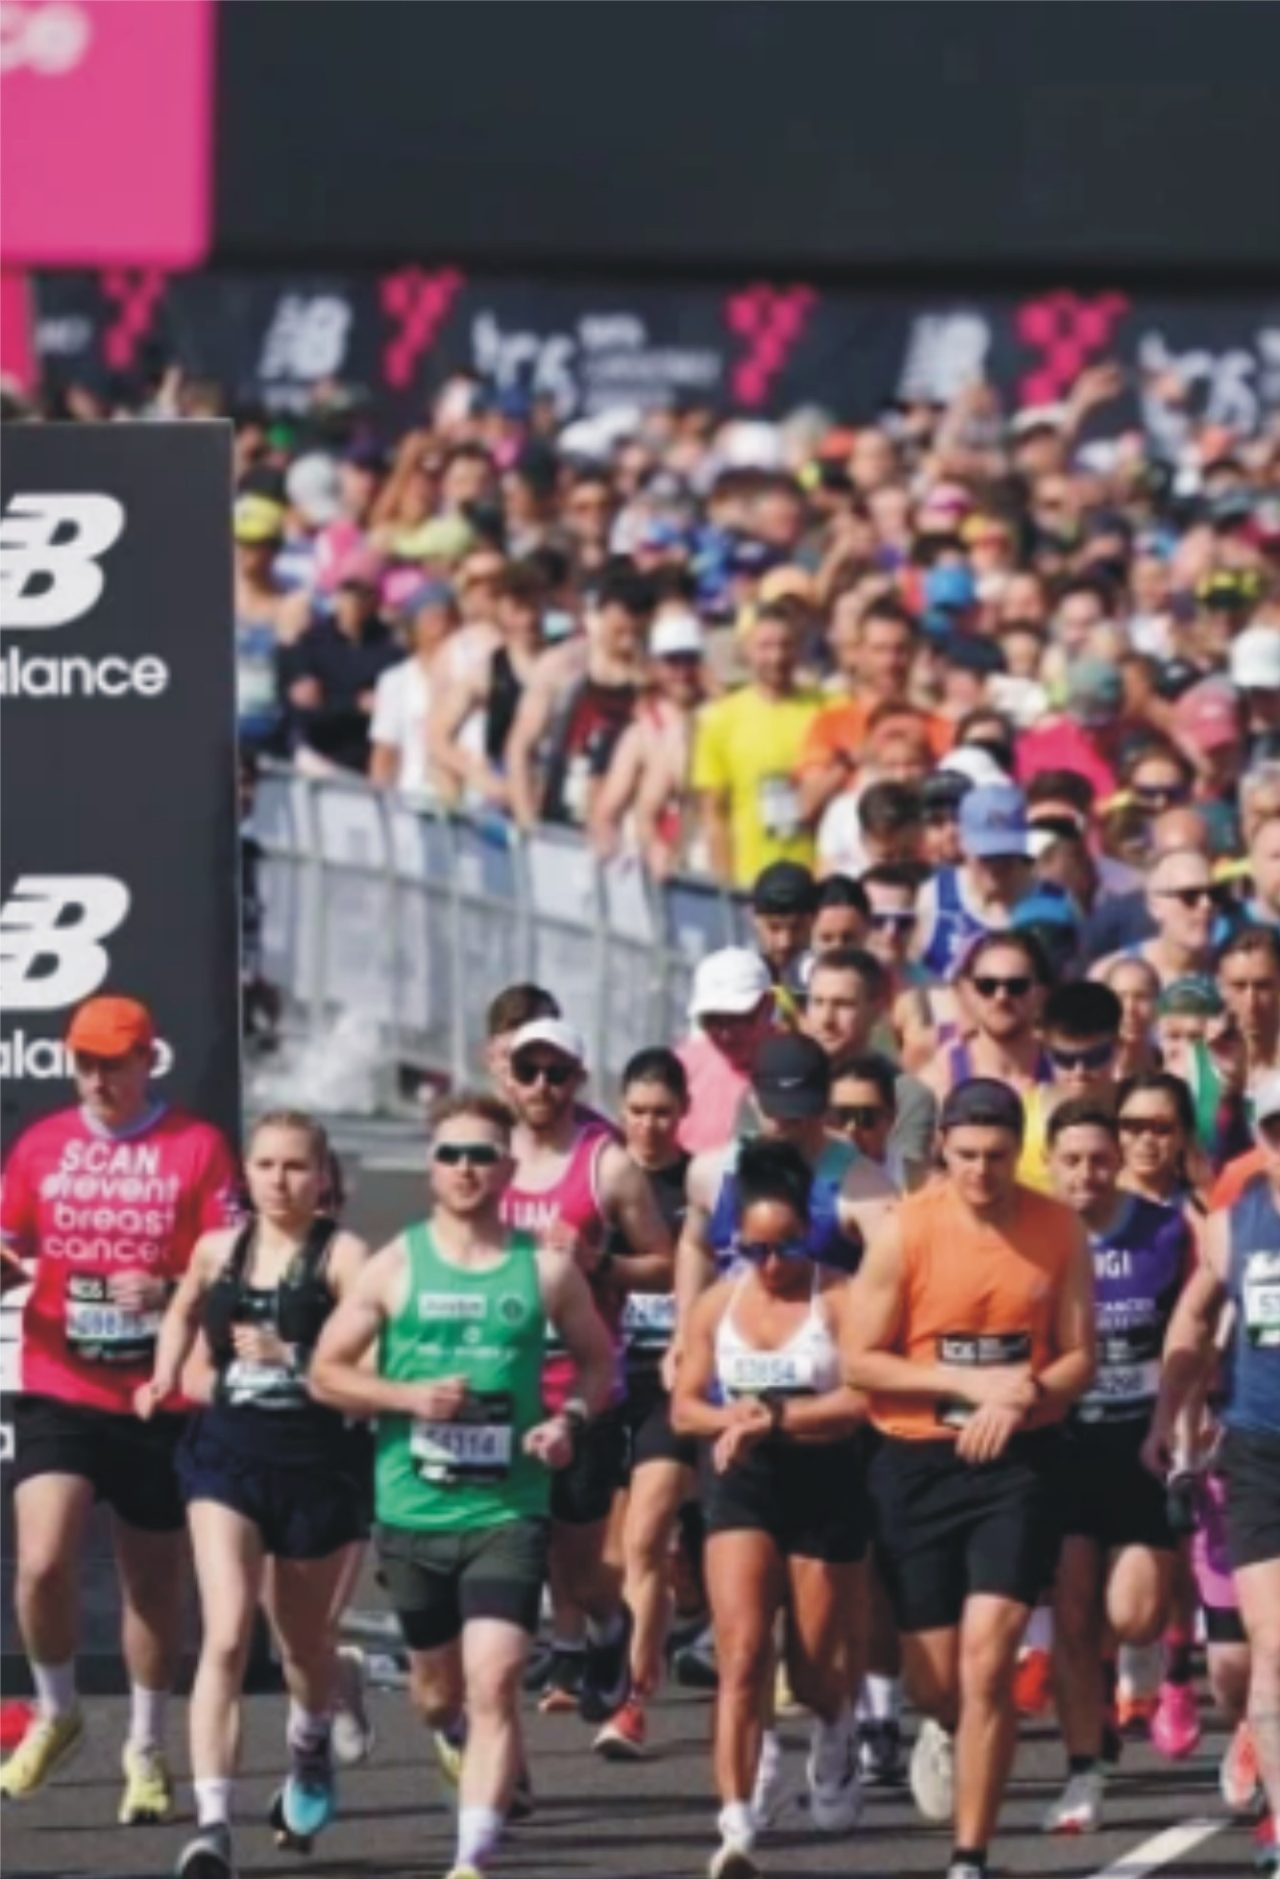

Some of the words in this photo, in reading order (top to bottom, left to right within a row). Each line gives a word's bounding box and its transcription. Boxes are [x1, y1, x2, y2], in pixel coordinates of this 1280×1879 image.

[0, 492, 126, 629] B
[0, 646, 168, 696] lance
[0, 874, 130, 1010] B
[60, 1139, 160, 1176] SCAN
[54, 1203, 175, 1236] breast
